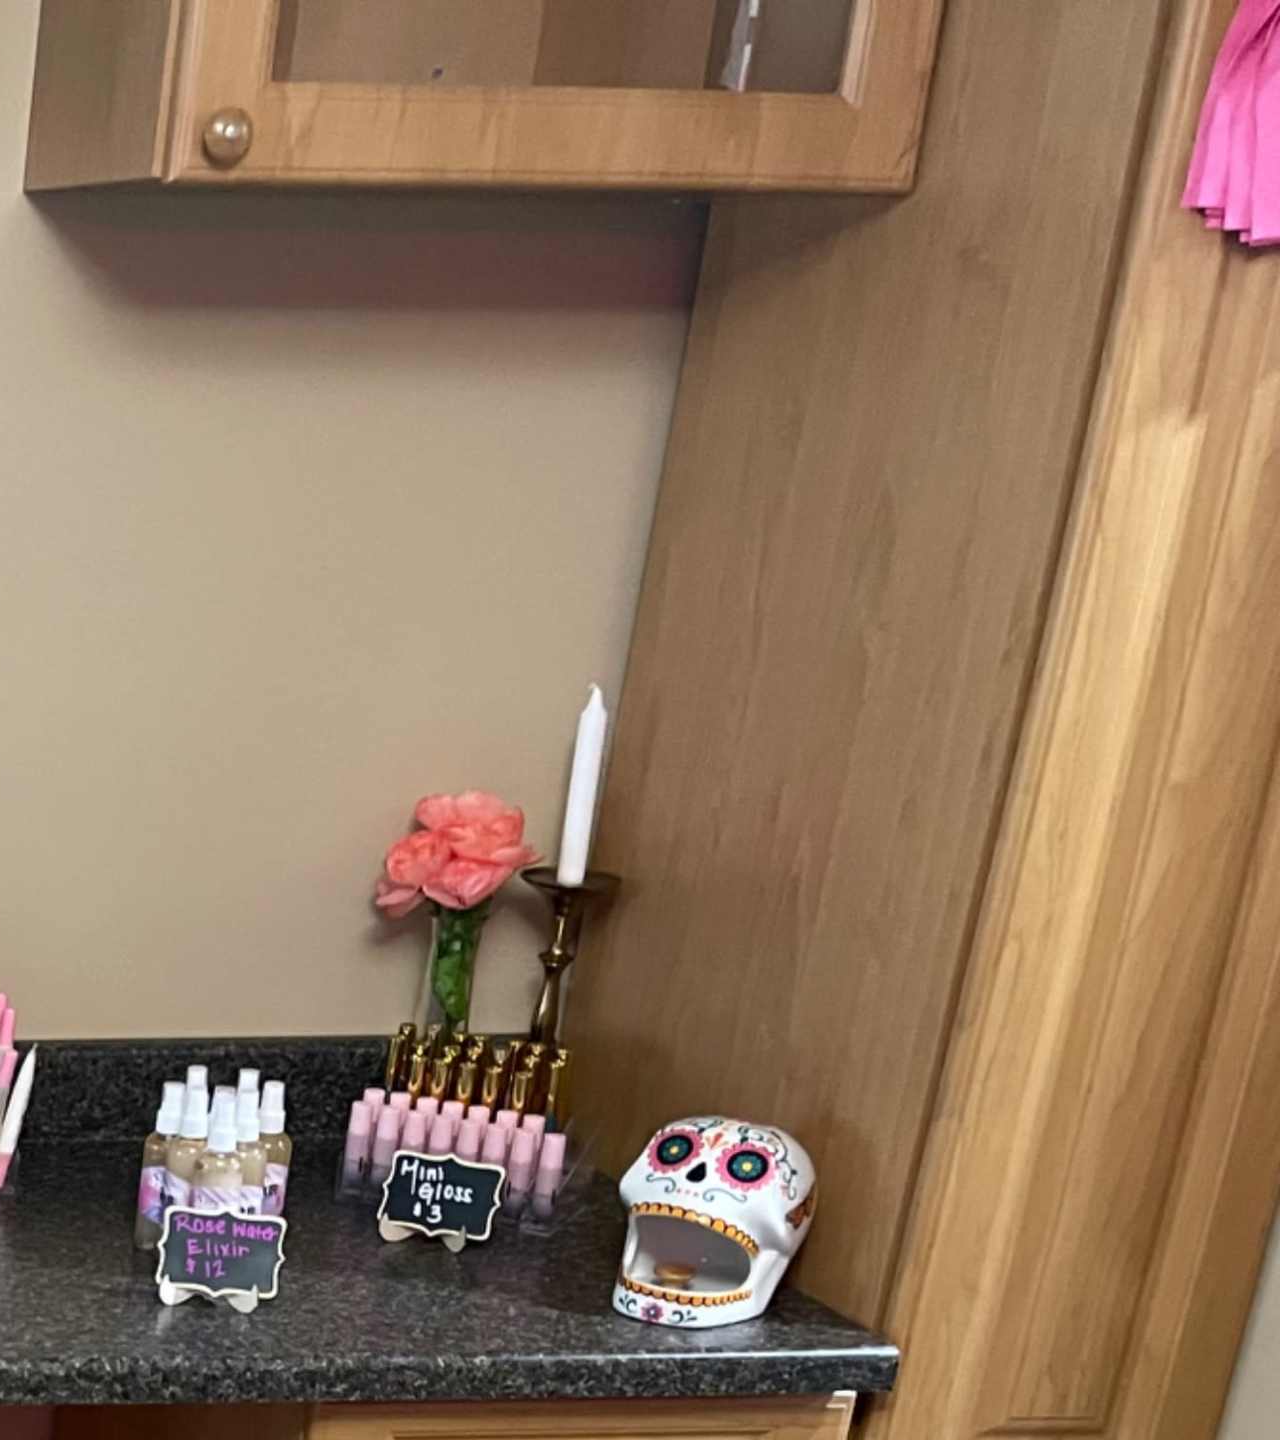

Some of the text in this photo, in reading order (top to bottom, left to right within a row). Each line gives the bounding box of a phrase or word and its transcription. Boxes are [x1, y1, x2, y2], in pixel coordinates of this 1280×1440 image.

[400, 1158, 444, 1196] Mini
[418, 1182, 473, 1206] Gloss
[175, 1214, 226, 1235] Rose
[186, 1239, 251, 1258] Elixir
